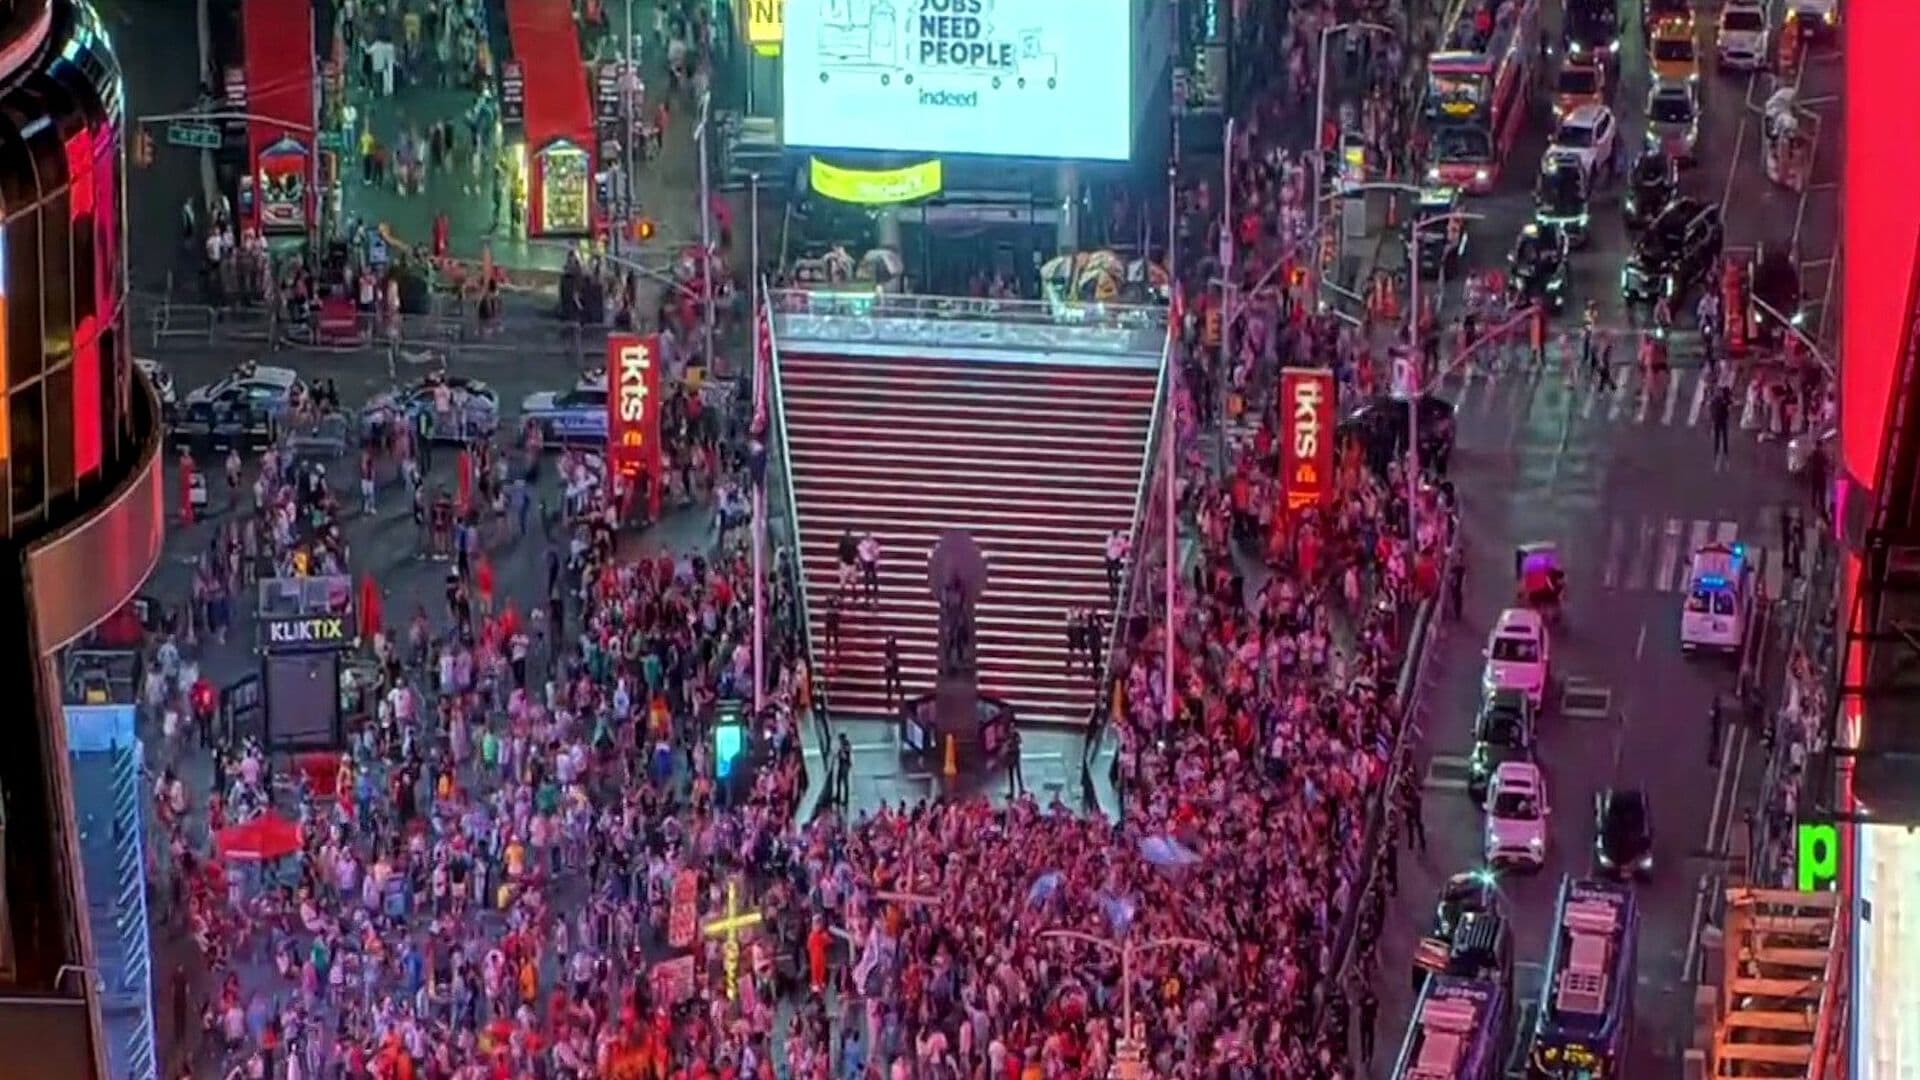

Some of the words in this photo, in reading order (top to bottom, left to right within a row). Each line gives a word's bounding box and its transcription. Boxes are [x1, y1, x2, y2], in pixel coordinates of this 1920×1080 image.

[920, 15, 980, 39] NEED
[920, 41, 1012, 66] PEOPLE
[919, 88, 977, 107] indeed
[620, 345, 650, 422] tkts
[1295, 382, 1323, 458] tkts
[271, 619, 342, 641] KLIKTIX
